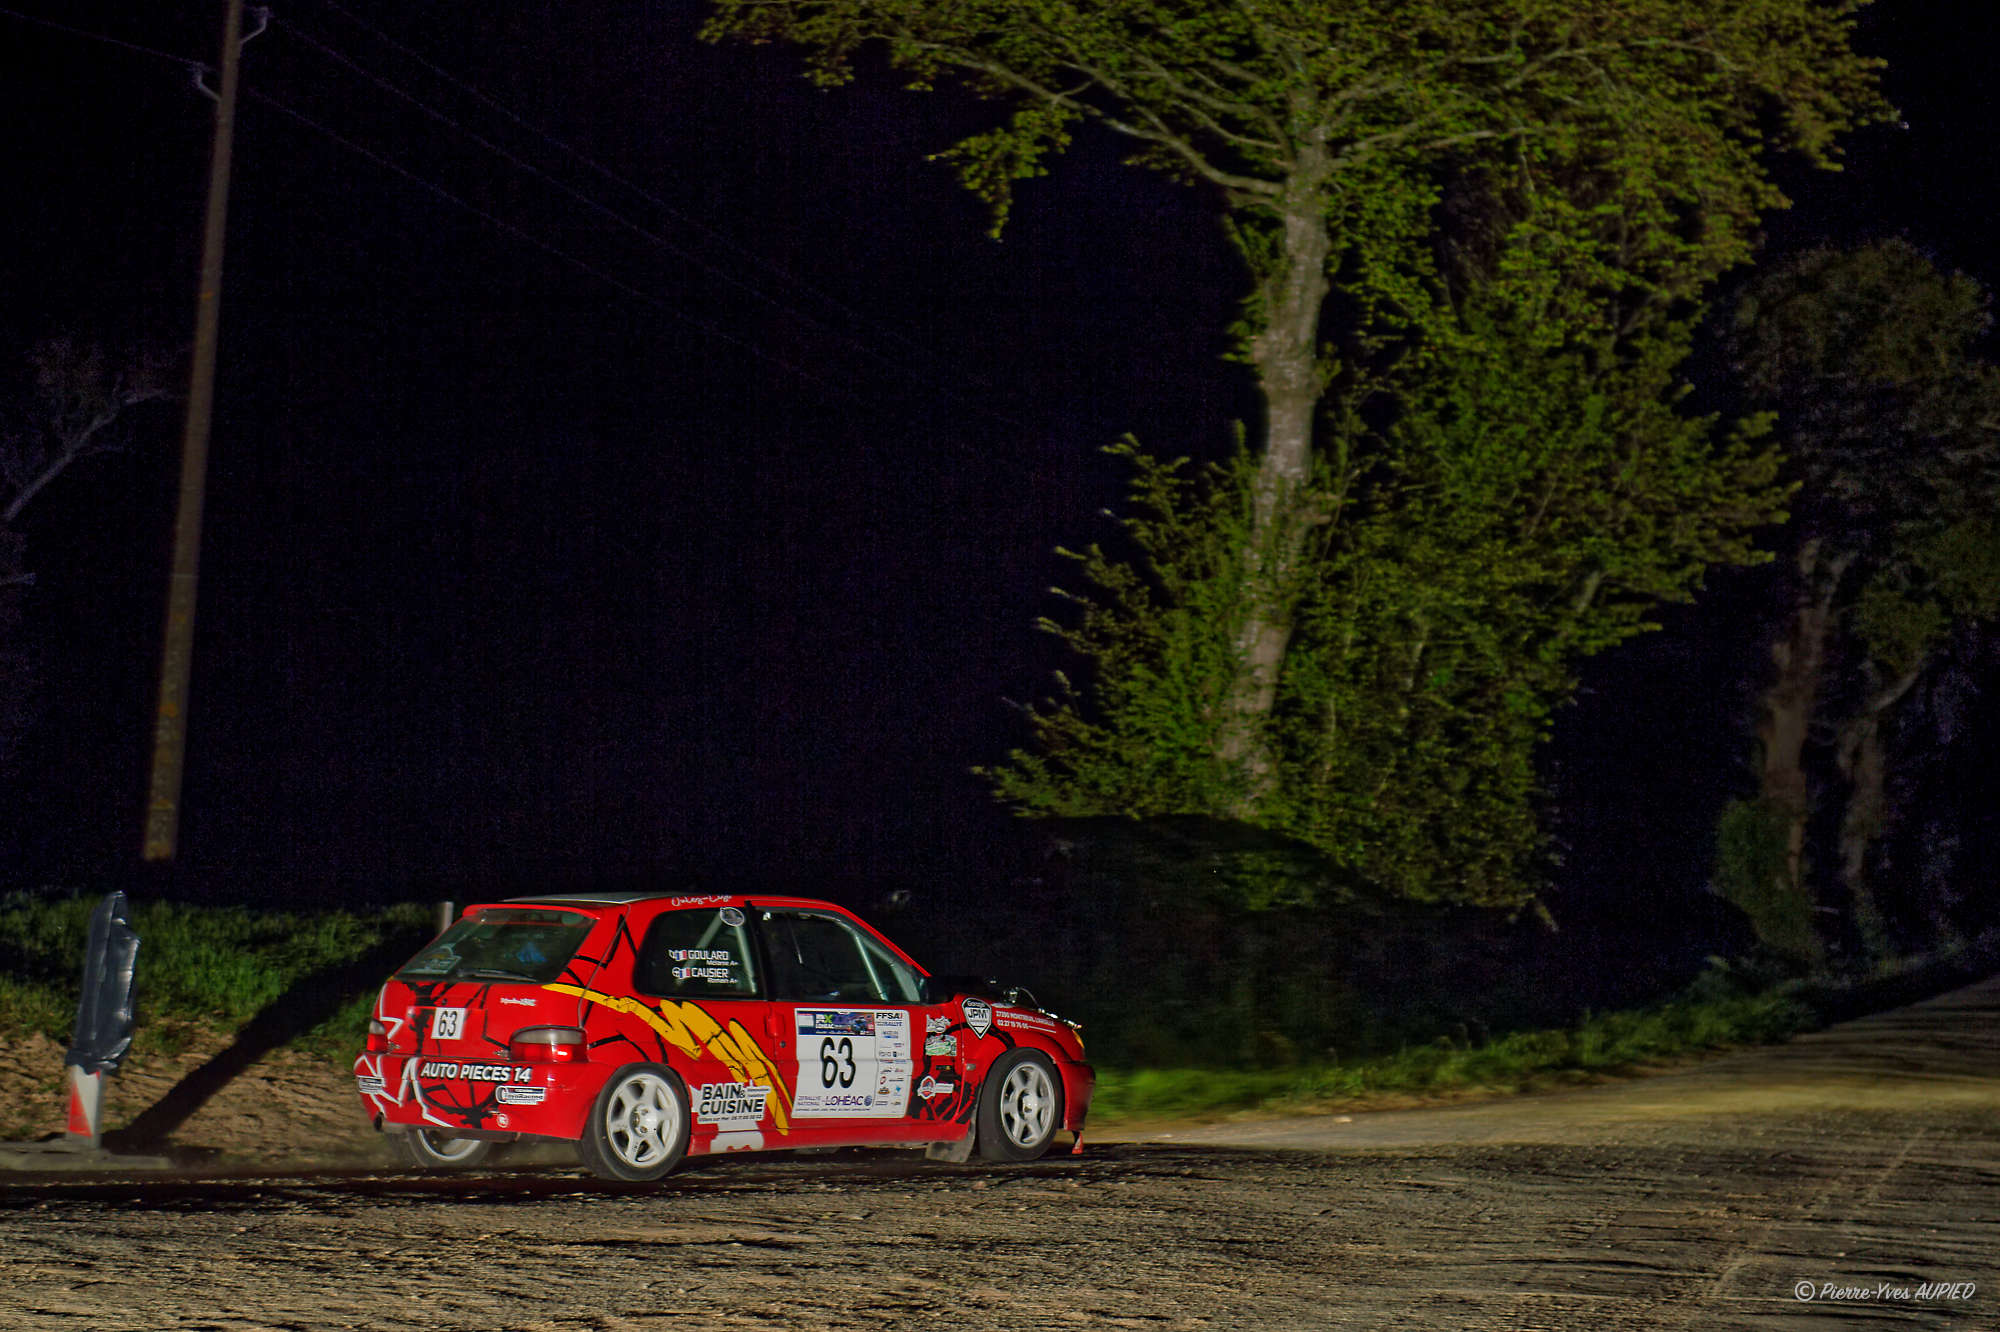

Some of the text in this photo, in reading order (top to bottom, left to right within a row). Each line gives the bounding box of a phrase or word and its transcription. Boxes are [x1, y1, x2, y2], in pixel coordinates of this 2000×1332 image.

[688, 950, 729, 960] GOULARD
[691, 967, 729, 978] CAUSIER
[967, 1009, 988, 1019] JPM
[438, 1010, 458, 1037] 63
[820, 1036, 856, 1089] 63
[420, 1062, 532, 1083] AUTO PIECES 14
[702, 1084, 742, 1100] BAIN
[700, 1098, 764, 1116] CUISINE
